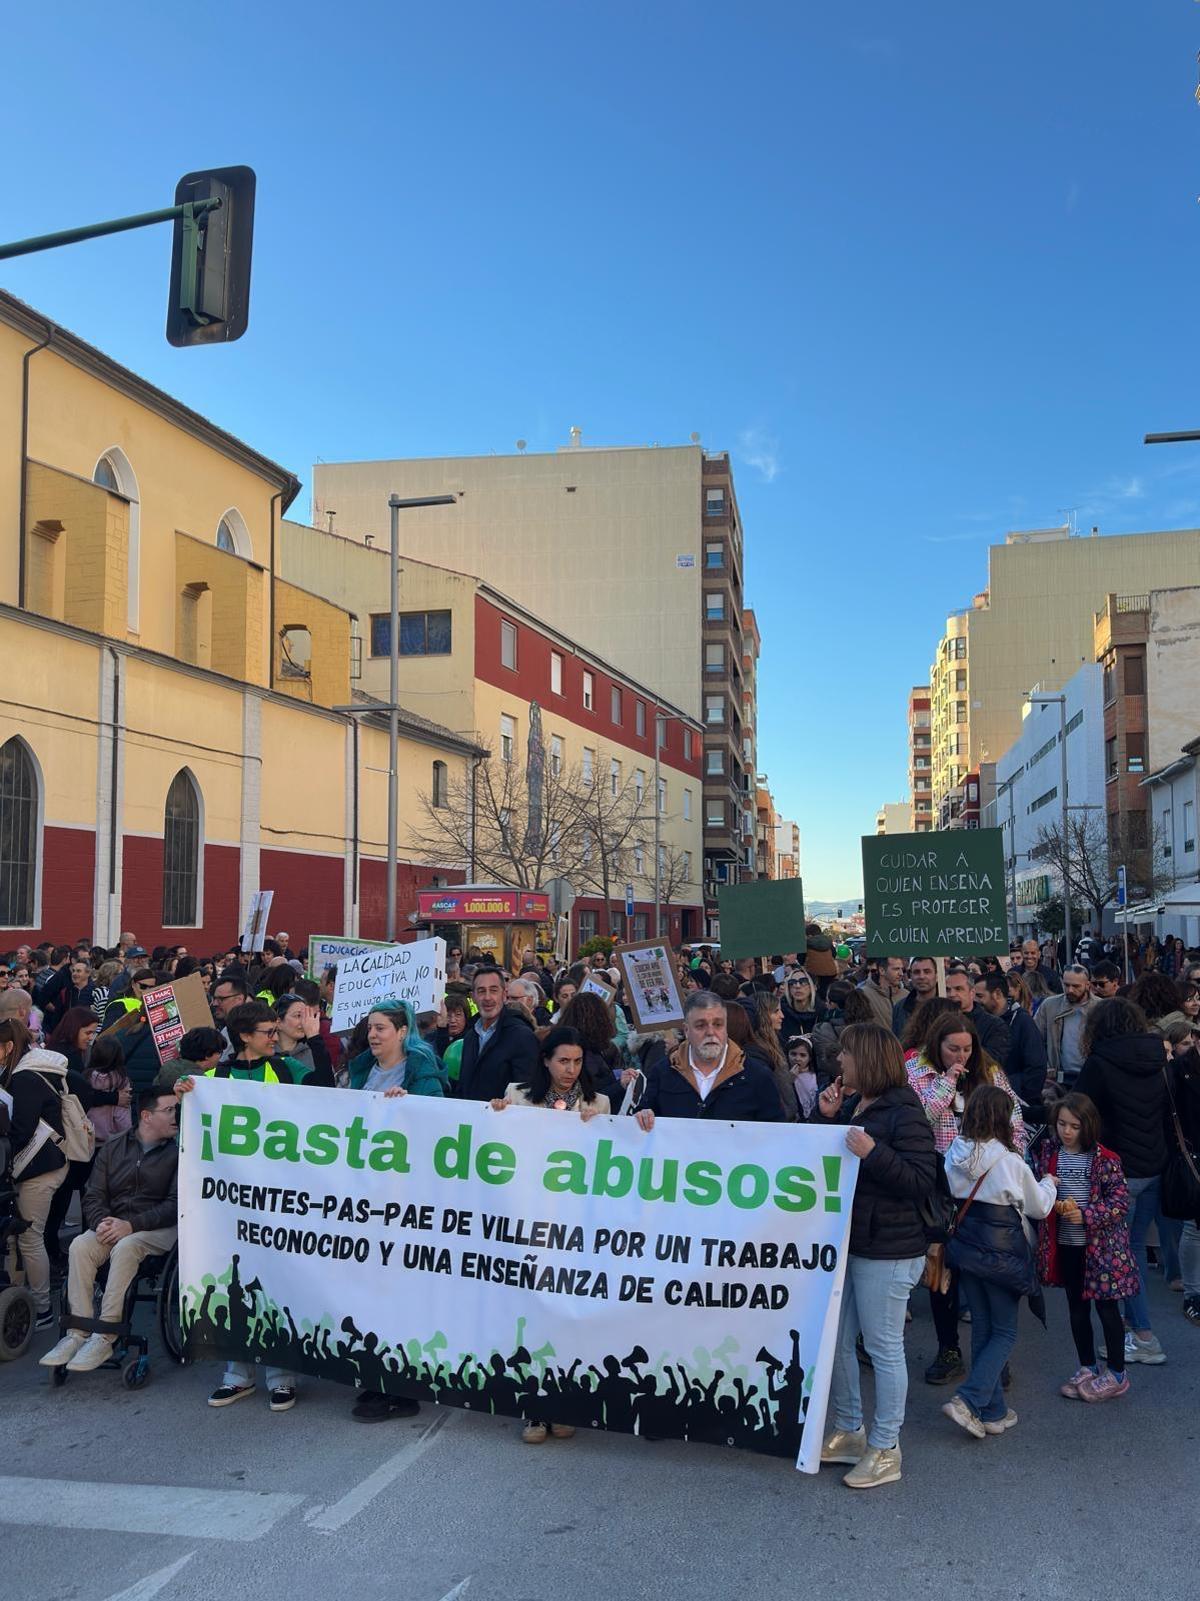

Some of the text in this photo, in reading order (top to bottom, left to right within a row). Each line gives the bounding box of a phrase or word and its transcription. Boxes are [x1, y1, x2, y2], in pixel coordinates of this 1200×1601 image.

[880, 851, 969, 869] CUIDAR A
[876, 871, 993, 893] QUIEN ENSEÑA
[881, 897, 991, 918] ES PROTEGER
[871, 929, 884, 944] A
[936, 926, 1004, 944] APRENDE
[343, 958, 360, 974] LA
[360, 950, 412, 974] CALIDAD
[338, 965, 430, 994] EDUCATIVA NO
[145, 995, 155, 1004] 31
[337, 1001, 349, 1012] ES
[351, 999, 361, 1009] UN
[383, 991, 396, 1001] ES
[156, 1035, 165, 1043] 31
[201, 1104, 841, 1212] ¡Basta de abusos!
[442, 1208, 473, 1236] DE
[481, 1213, 585, 1253] VILLENA
[594, 1229, 646, 1258] POR
[655, 1235, 693, 1264] UN
[701, 1238, 838, 1273] TRABAJO
[237, 1219, 790, 1310] RECONOCIDO Y UNA ENSEÑANZA DE CALIDAD
